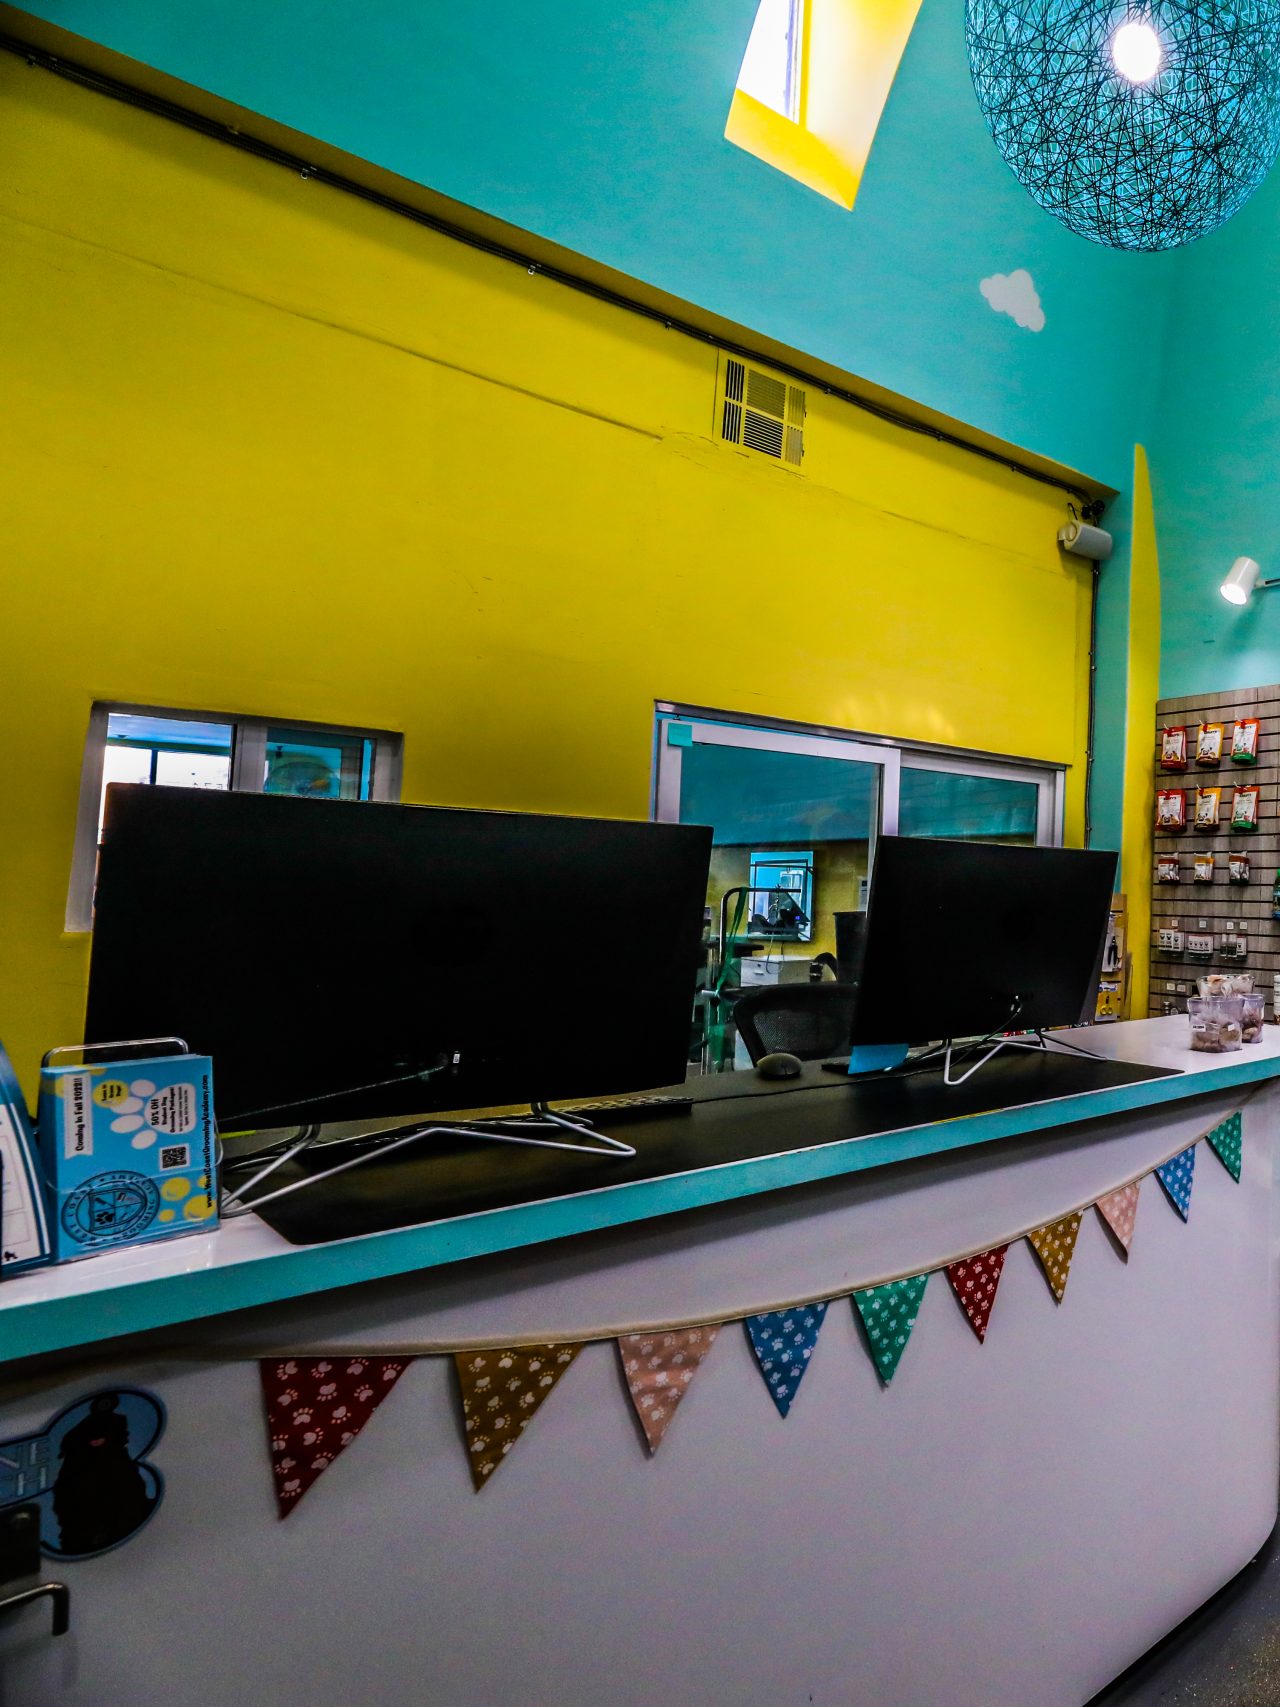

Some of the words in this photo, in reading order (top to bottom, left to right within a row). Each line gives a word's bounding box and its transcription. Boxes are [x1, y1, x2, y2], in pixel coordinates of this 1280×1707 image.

[74, 1102, 84, 1115] Fall
[151, 1098, 159, 1110] Off
[151, 1111, 160, 1126] 50%
[75, 1123, 86, 1152] Coming
